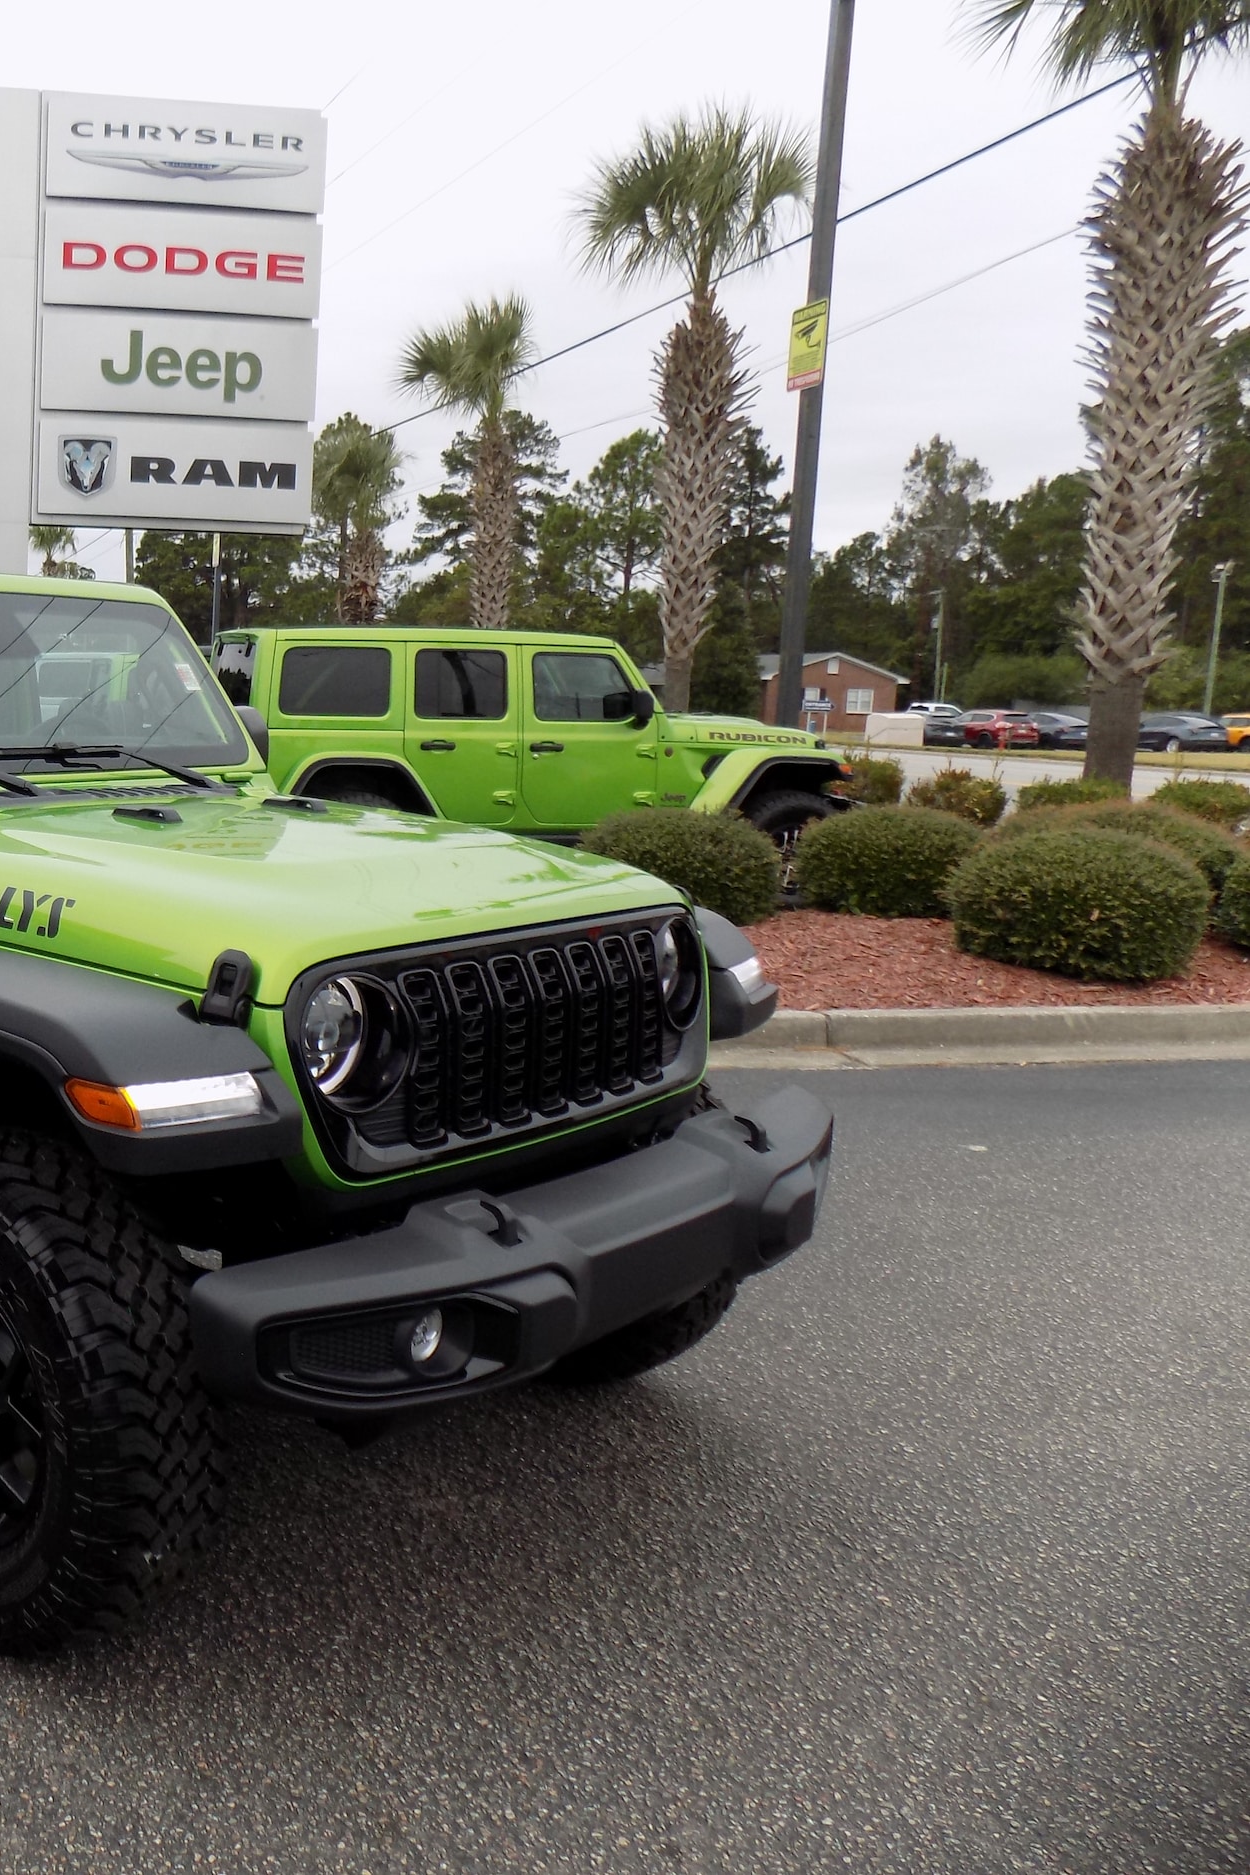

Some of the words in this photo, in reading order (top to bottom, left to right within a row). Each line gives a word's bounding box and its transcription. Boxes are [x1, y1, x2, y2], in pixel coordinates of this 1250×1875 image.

[70, 121, 304, 152] CHRYSLER
[62, 241, 305, 284] DODGE
[100, 330, 263, 404] Jeep
[130, 456, 297, 490] RAM
[709, 732, 807, 745] RUBICON
